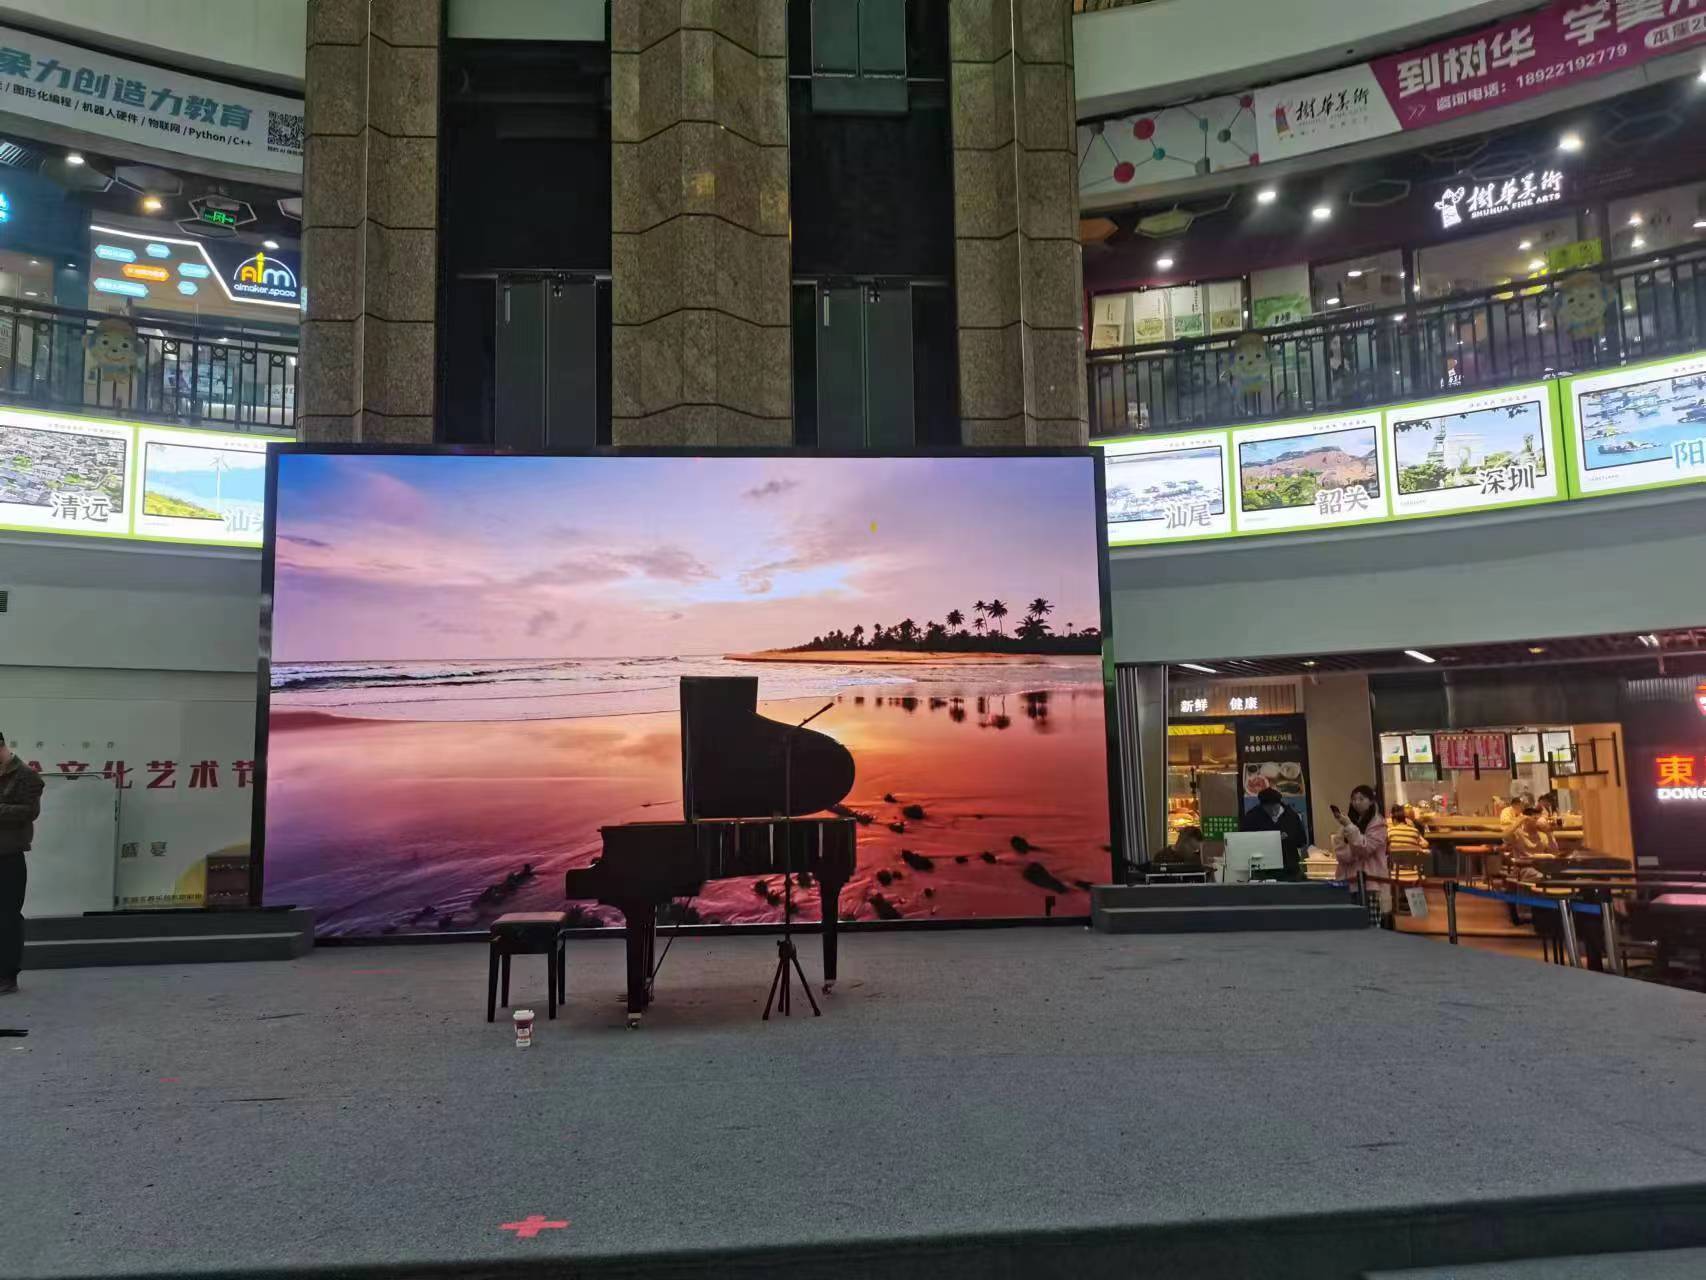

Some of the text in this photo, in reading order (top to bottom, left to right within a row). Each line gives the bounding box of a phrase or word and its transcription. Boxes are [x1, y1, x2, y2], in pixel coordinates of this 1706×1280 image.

[1397, 24, 1535, 98] 到树华
[1516, 43, 1628, 89] 18922192779
[1471, 192, 1561, 219] SHUHUA FINE ARTS
[1478, 464, 1536, 495] 深圳
[51, 494, 110, 523] 清远
[1166, 503, 1211, 529] 汕尾
[1316, 486, 1369, 516] 韶关
[1180, 696, 1258, 713] 新鲜 健康
[1655, 755, 1706, 787] 東
